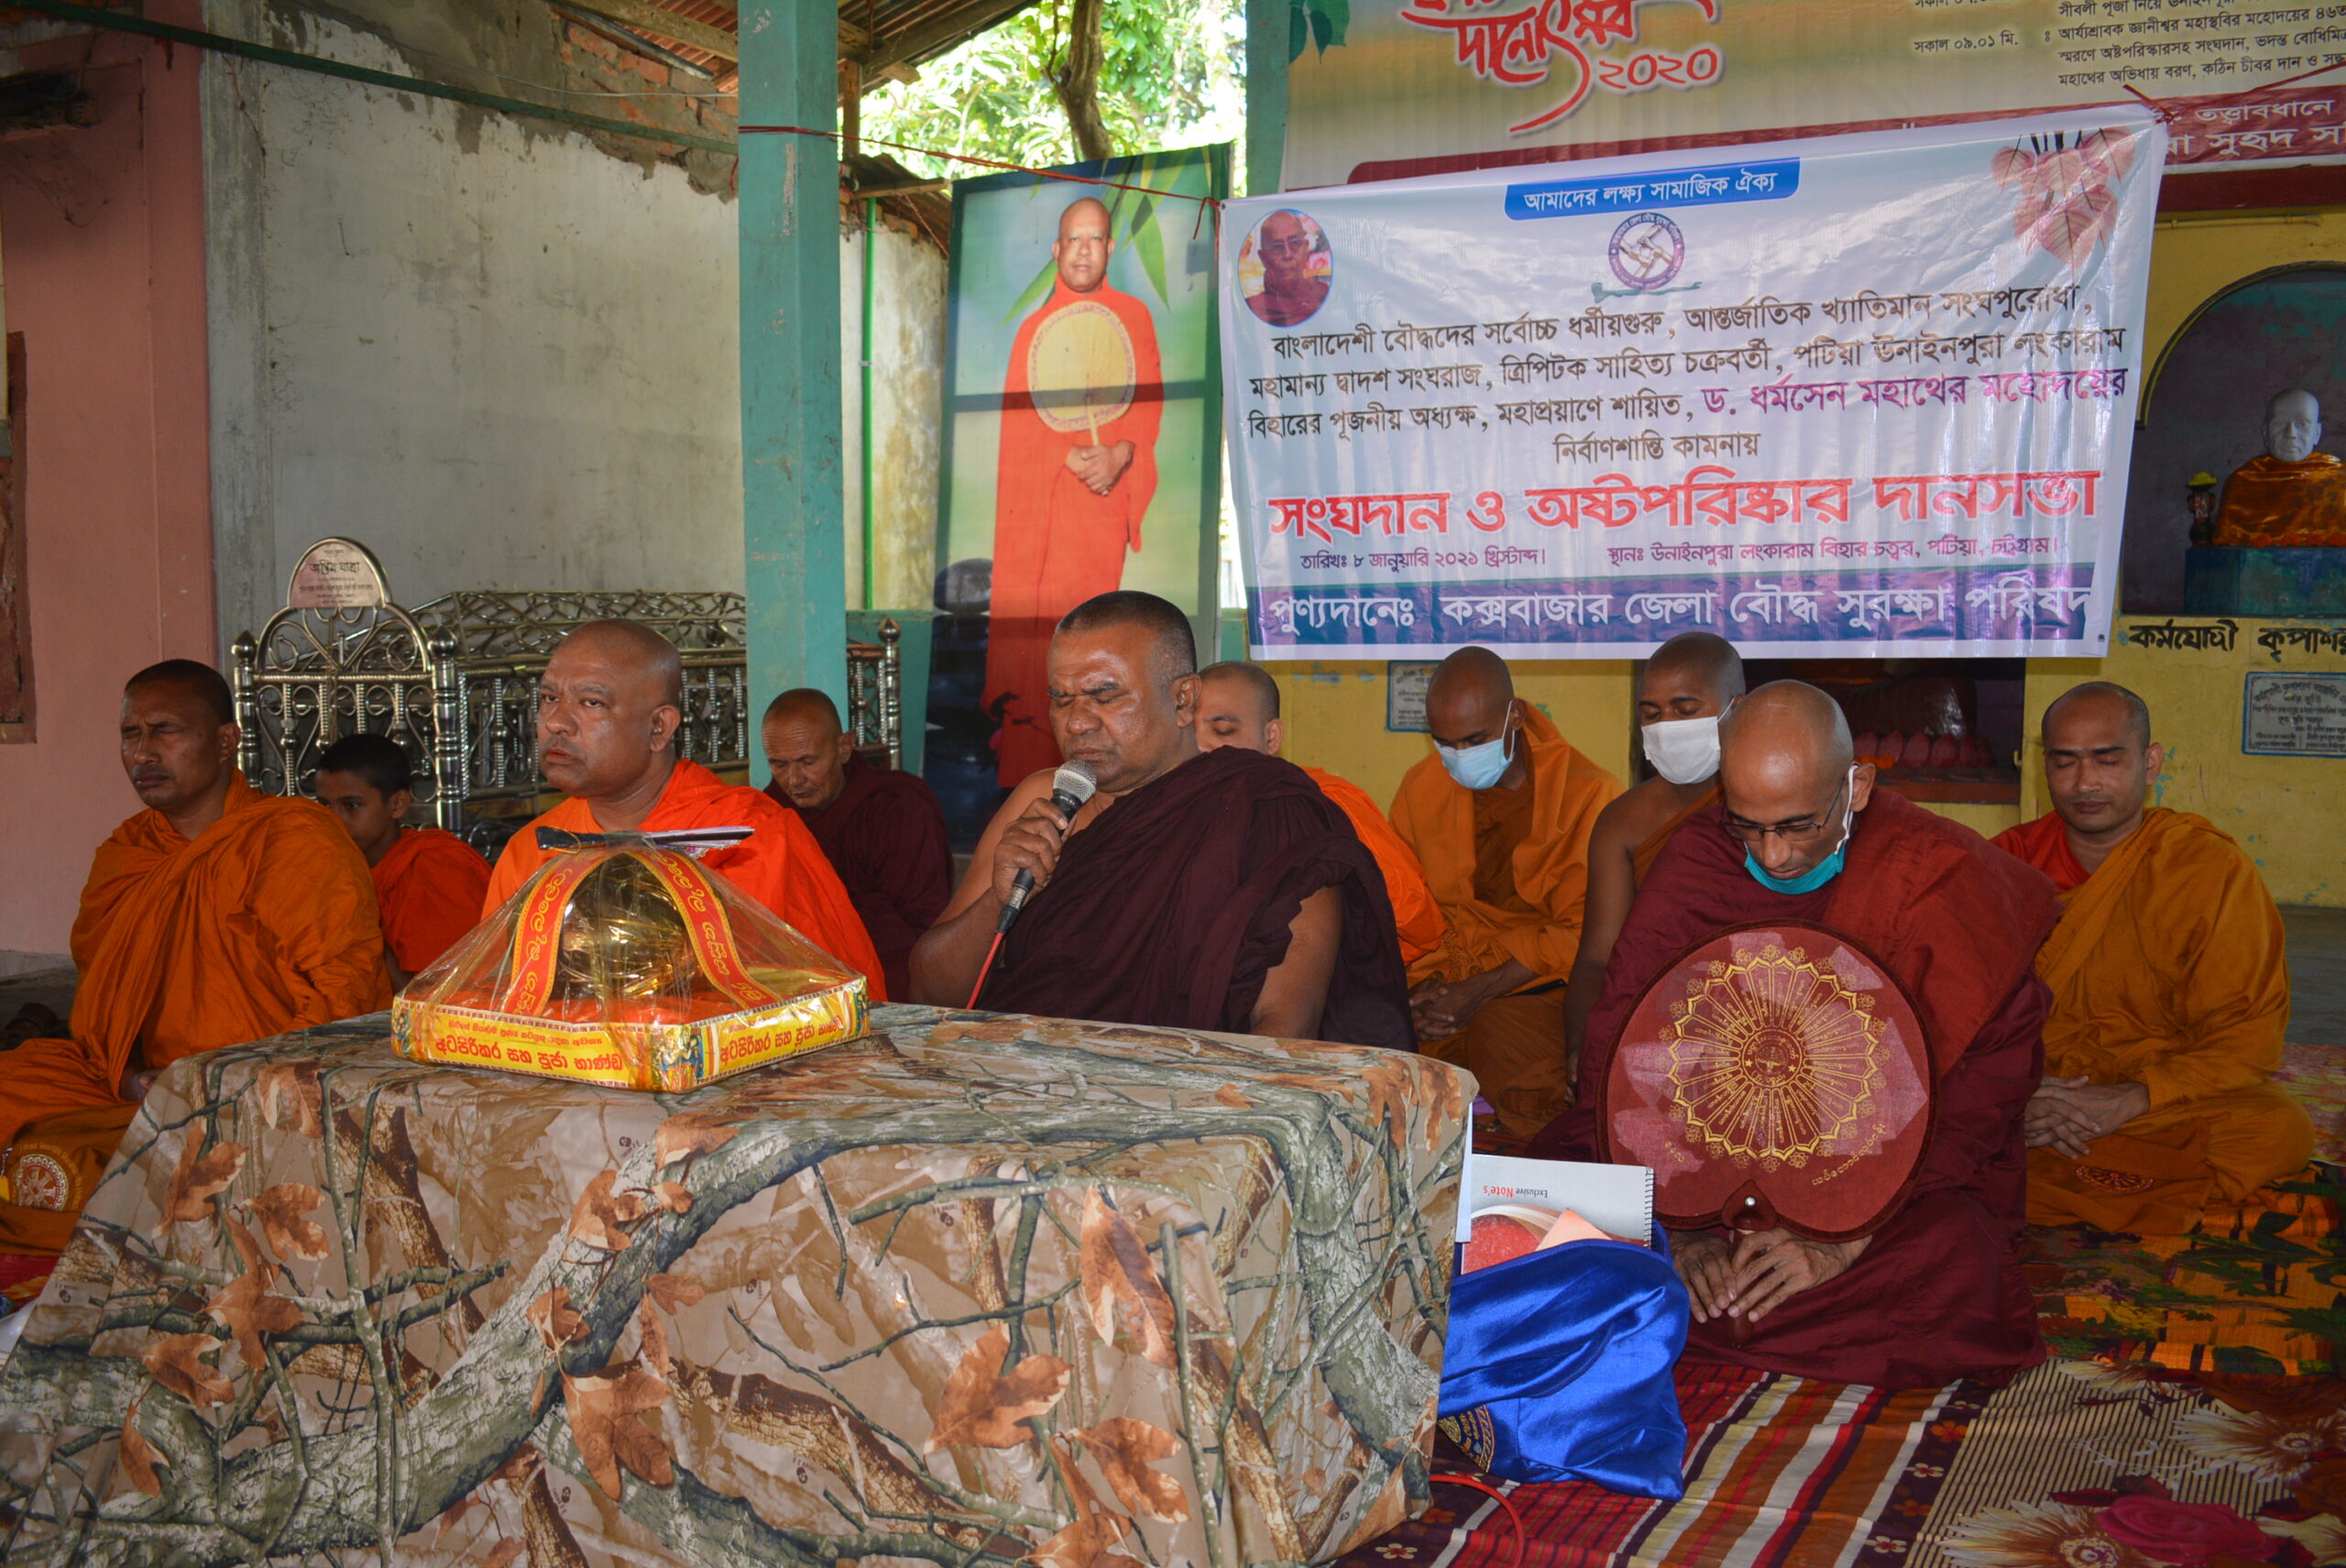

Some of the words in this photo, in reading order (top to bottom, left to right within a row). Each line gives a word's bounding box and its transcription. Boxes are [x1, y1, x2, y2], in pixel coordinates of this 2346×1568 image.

[2058, 0, 2097, 17] সীবলী
[1913, 38, 1949, 52] সকাল
[1954, 35, 1995, 49] ০৯.০১
[2001, 29, 2018, 46] মি.
[2129, 16, 2179, 35] জ্ঞানীশ্বর
[2185, 12, 2241, 30] মহাস্থবির
[2245, 9, 2309, 25] মহোদয়ের
[2058, 49, 2095, 63] স্মরণে
[2196, 38, 2250, 52] সংঘদান,
[2254, 34, 2288, 47] ভদন্ত
[1599, 49, 1718, 90] ২০২০
[2058, 71, 2106, 86] মহাথের
[2165, 63, 2196, 80] বরণ,
[2201, 57, 2236, 75] কঠিন
[2241, 56, 2273, 72] চীবর
[2277, 57, 2302, 69] দান
[2307, 56, 2318, 66] ও
[1523, 189, 1598, 212] আমাদের
[1603, 183, 1646, 205] লক্ষ্য
[1650, 174, 1730, 201] সামাজিক
[1735, 168, 1779, 193] ঐক্য
[1272, 323, 1376, 358] বাংলাদেশী
[1383, 321, 1478, 353] বৌদ্ধদের
[1483, 312, 1560, 345] সর্বোচ্চ
[1683, 295, 1812, 330] আন্তর্জাতিক
[1822, 290, 1934, 323] খ্যাতিমান
[1249, 373, 1327, 399] মহামান্য
[1332, 368, 1391, 395] দ্বাদশ
[1397, 363, 1492, 392] সংঘরাজ,
[1500, 352, 1587, 385] ত্রিপিটক
[1594, 347, 1675, 380] সাহিত্য
[1793, 334, 1863, 367] পটিয়া
[1870, 330, 2006, 366] উনাইনপুরা
[2013, 327, 2127, 358] লংকারাম
[1247, 410, 1322, 439] বিহারের
[1330, 401, 1403, 442] পূজনীয়
[1496, 394, 1603, 425] মহাপ্রয়াণে
[1701, 388, 1737, 415] ড.
[1750, 374, 1849, 413] ধর্মসেন
[1856, 372, 1970, 411] মহাথের
[1978, 368, 2128, 404] মহোদয়ের
[1552, 429, 1664, 464] নির্বাণশান্তি
[1671, 431, 1761, 458] কামনায়
[1268, 492, 1450, 543] সংঘদান
[1466, 491, 1506, 532] ও
[1524, 465, 1852, 529] অষ্টপরিষ্কার
[1872, 470, 2100, 521] দানসভা
[1300, 549, 1346, 570] তারিখঃ
[1354, 554, 1364, 568] ৮
[1369, 547, 1429, 573] জানুয়ারি
[1434, 552, 1478, 567] ২০২১
[1607, 546, 1644, 566] স্থানঃ
[1651, 542, 1734, 565] উনাইনপুরা
[1740, 542, 1814, 562] লংকারাম
[1820, 537, 1868, 558] বিহার
[1269, 595, 1414, 636] পুণ্যদানেঃ
[1439, 591, 1613, 628] কক্সবাজার
[1624, 588, 1718, 625] জেলা
[1729, 579, 1824, 625] বৌদ্ধ
[1833, 586, 1952, 631] সুরক্ষা
[1965, 576, 2092, 621] পরিষদ
[435, 1035, 501, 1059] අටපිරිකර
[507, 1047, 532, 1063] සහ
[774, 1031, 793, 1048] සහ
[1483, 1185, 1514, 1198] Note's
[1515, 1187, 1548, 1198] Exclusive
